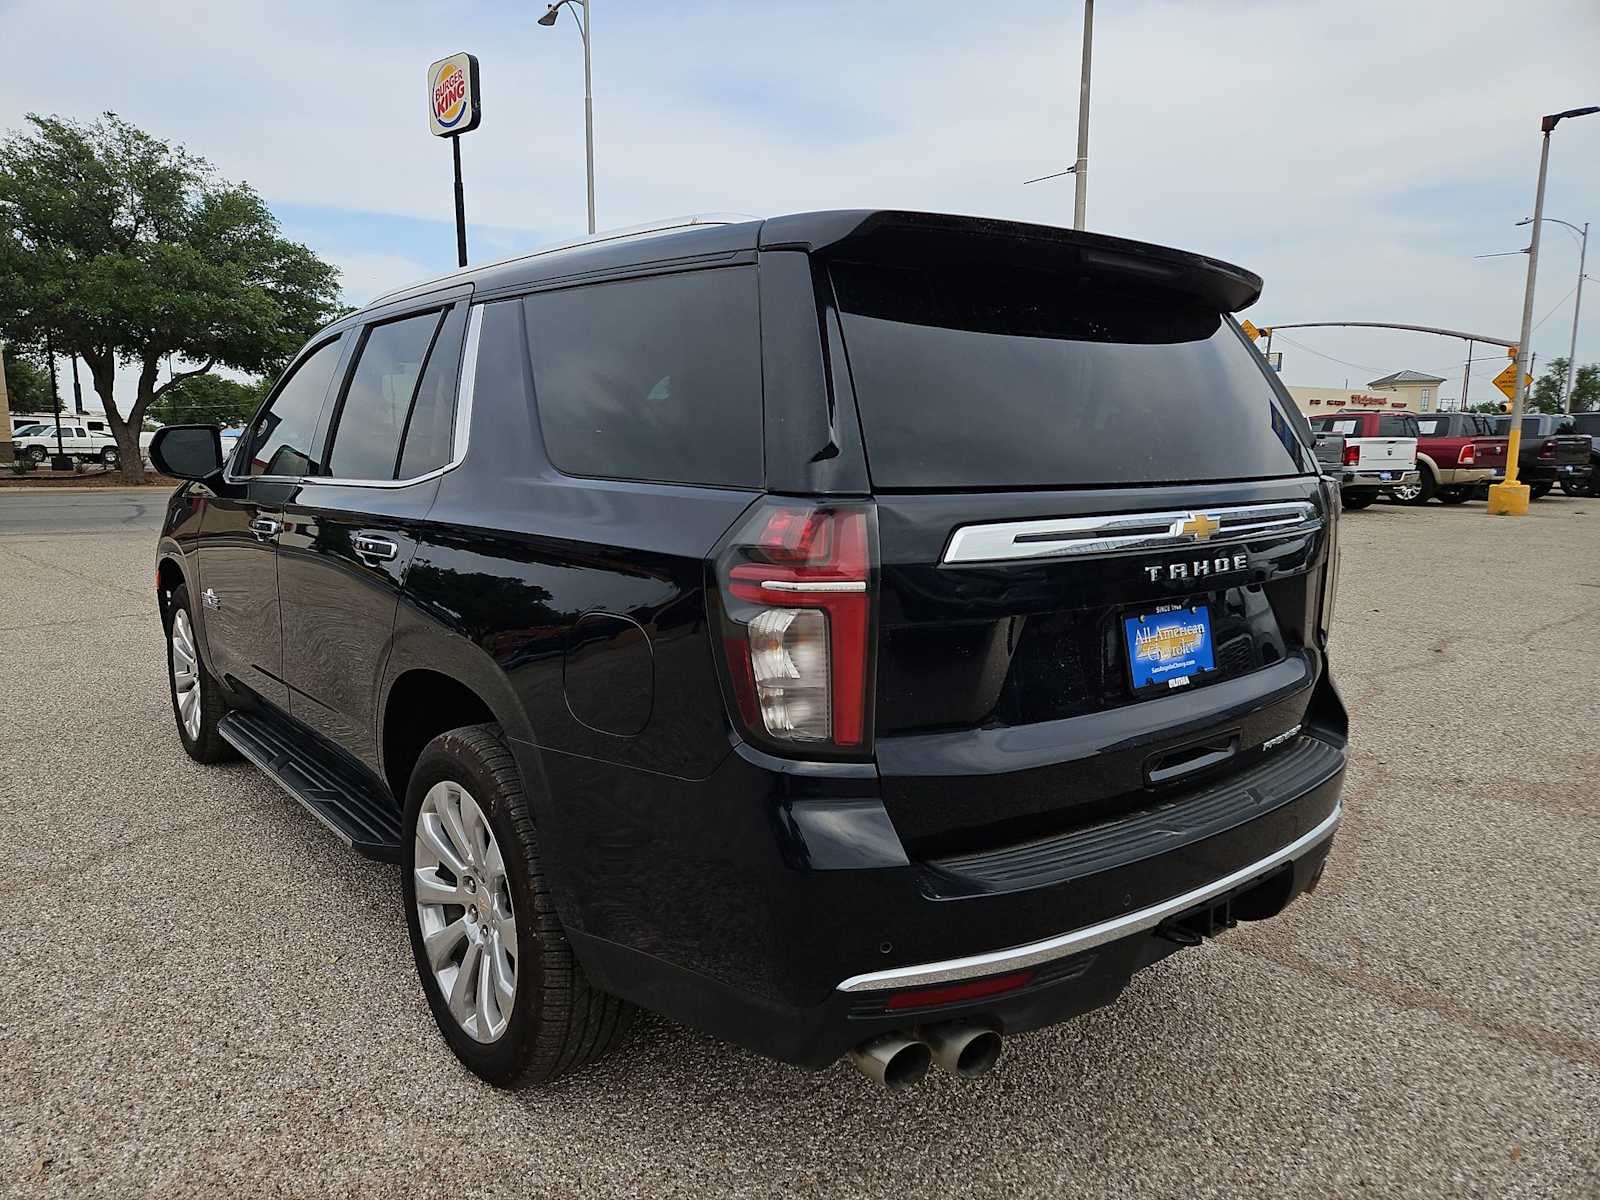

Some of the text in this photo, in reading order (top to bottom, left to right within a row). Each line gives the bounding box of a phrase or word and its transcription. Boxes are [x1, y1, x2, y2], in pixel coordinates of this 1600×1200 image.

[435, 69, 463, 102] BURGER
[437, 80, 465, 117] KING
[1144, 555, 1247, 582] TAHOE
[1135, 622, 1205, 645] All American
